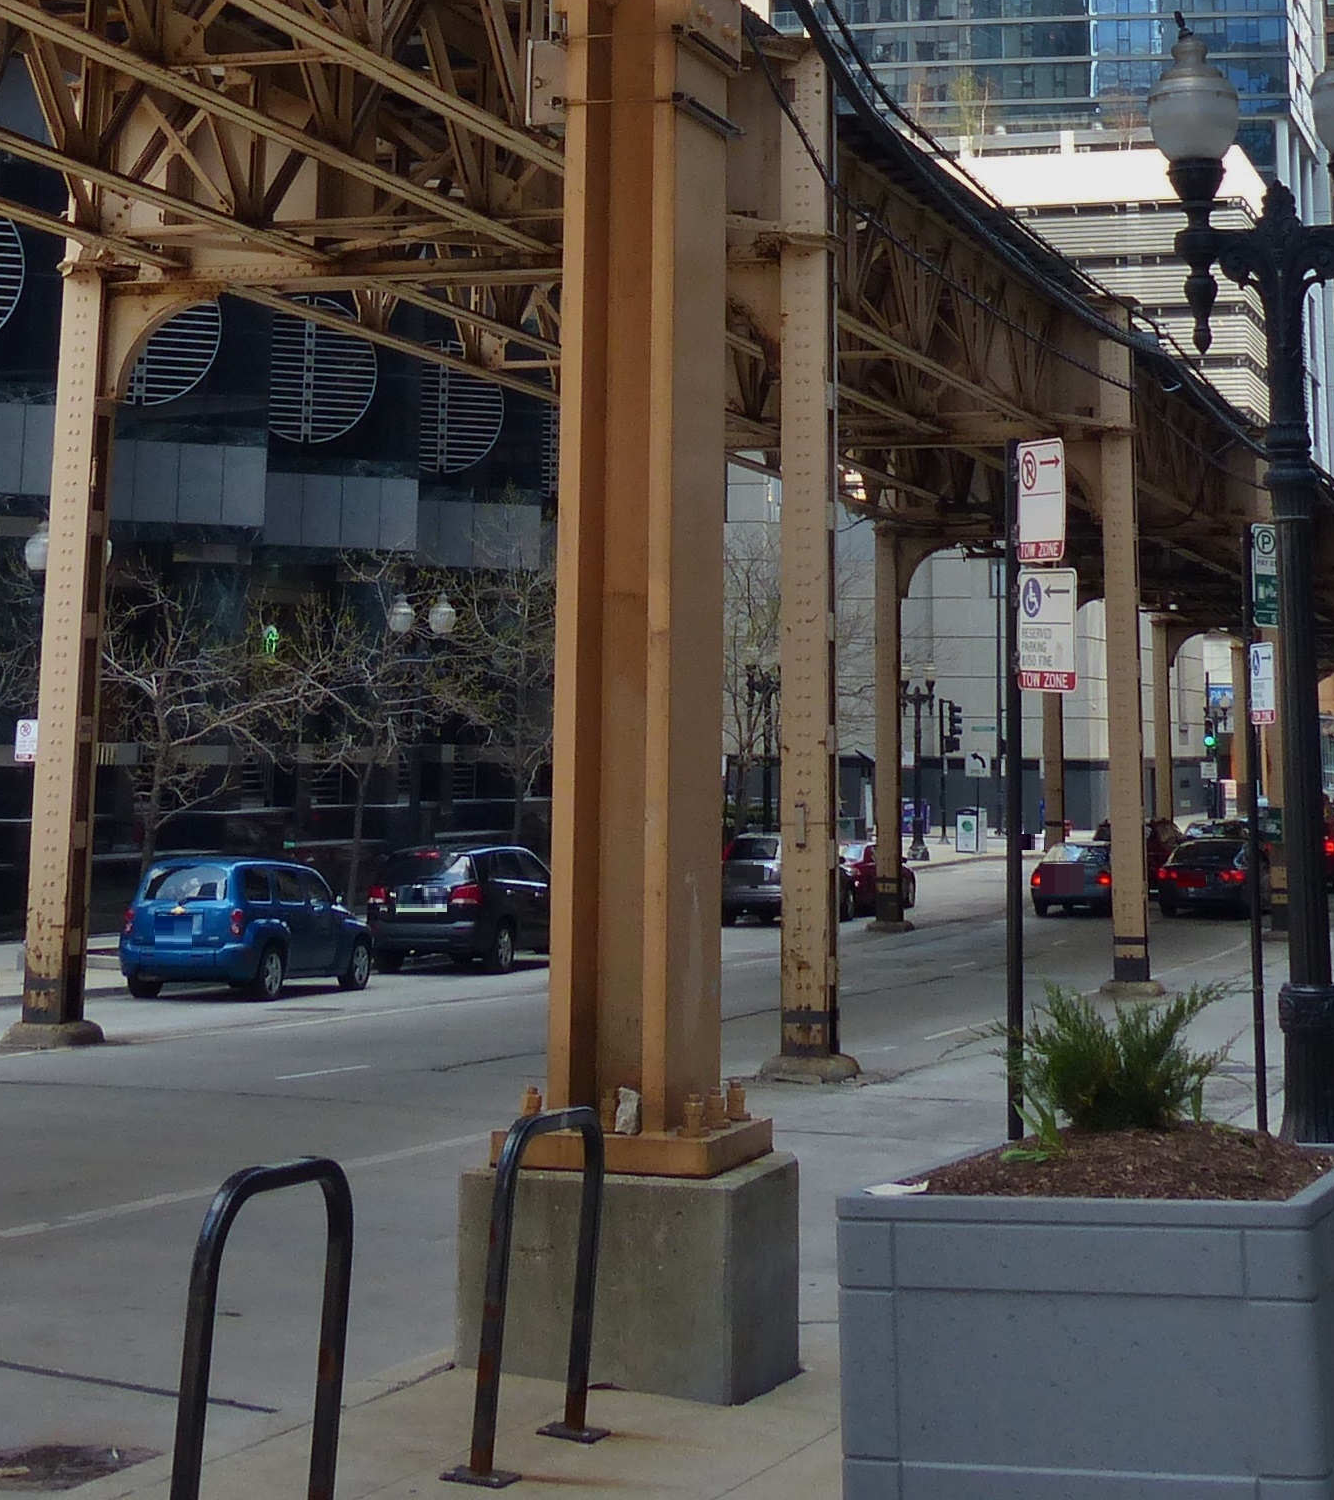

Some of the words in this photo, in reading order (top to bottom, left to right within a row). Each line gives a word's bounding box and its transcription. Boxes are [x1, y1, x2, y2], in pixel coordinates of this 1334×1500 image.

[1020, 543, 1036, 558] TOW
[1039, 542, 1059, 557] ZONE
[1021, 672, 1041, 687] TOW
[1044, 672, 1069, 688] ZONE
